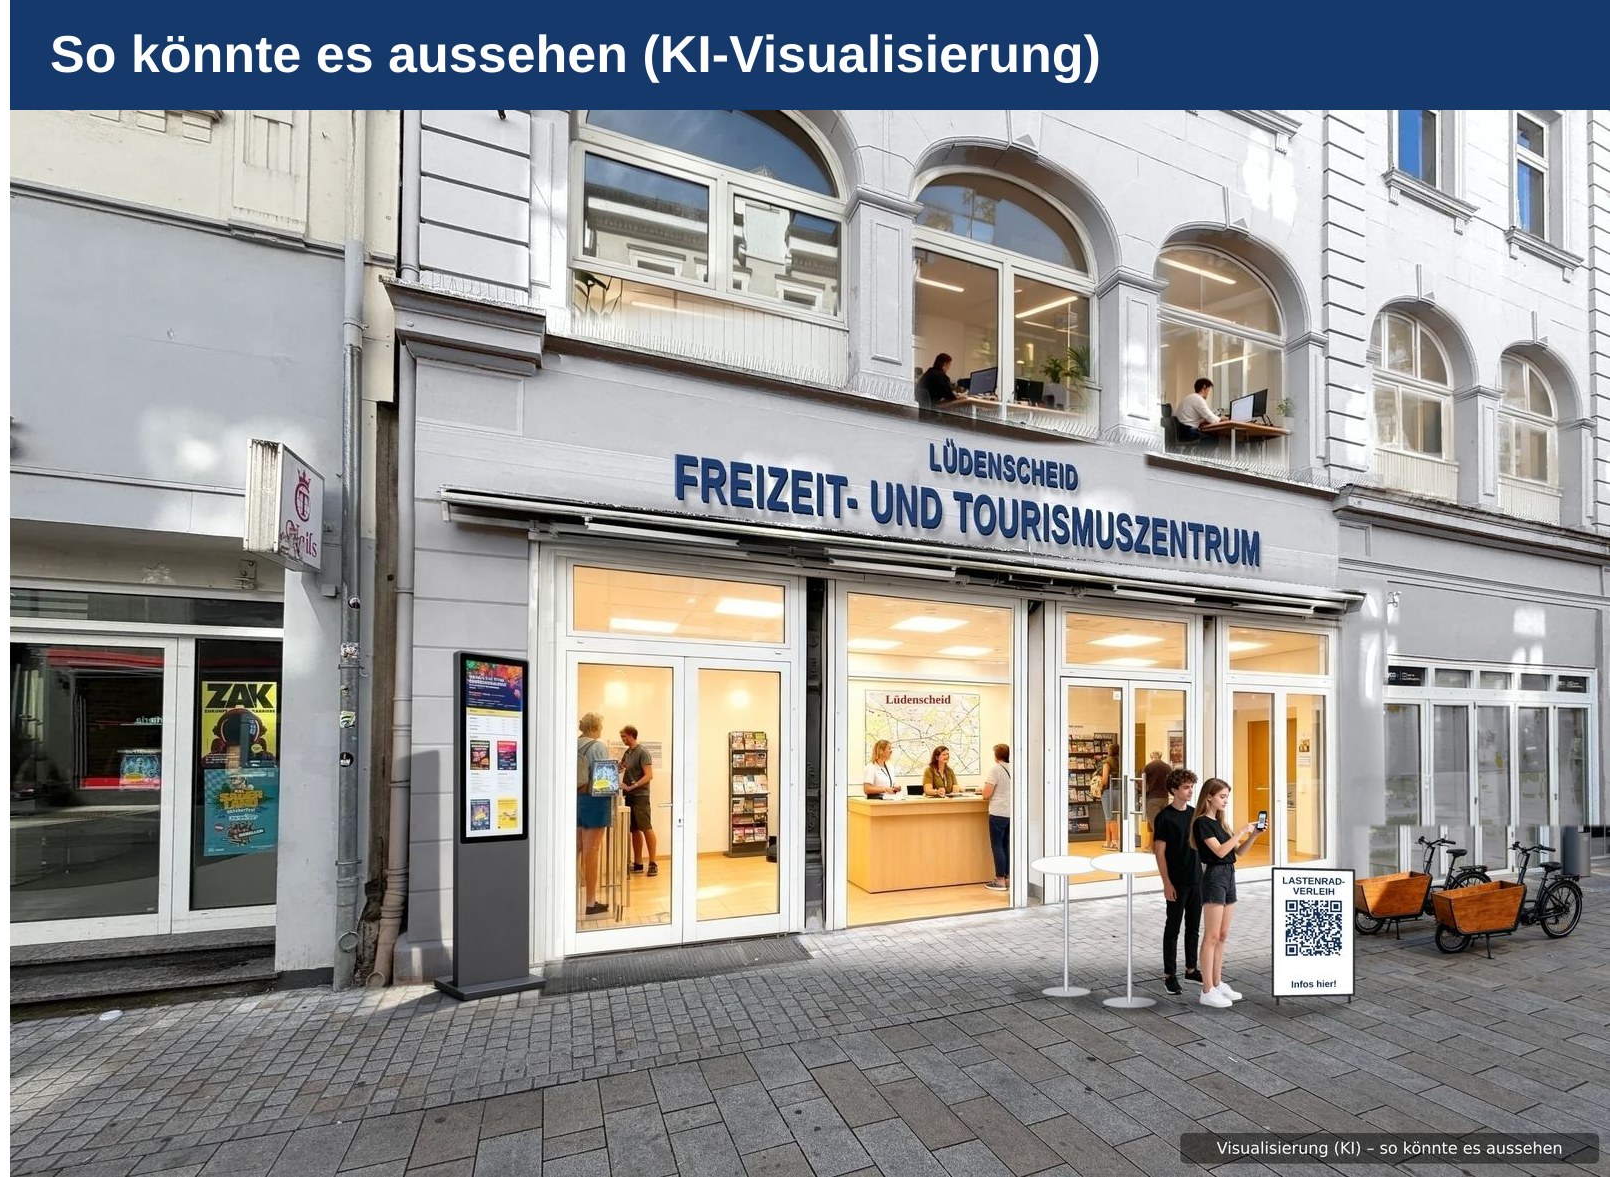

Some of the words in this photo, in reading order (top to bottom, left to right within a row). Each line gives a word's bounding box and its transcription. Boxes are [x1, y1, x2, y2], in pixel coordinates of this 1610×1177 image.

[929, 438, 1079, 491] LÜDENSCHEID
[675, 453, 858, 519] FREIZEIT-
[870, 480, 943, 530] UND
[953, 492, 1261, 567] TOURISMUSZENTRUM
[205, 683, 275, 709] ZAK
[885, 694, 952, 705] Lüdenscheid
[1282, 876, 1346, 886] LASTENRAD-
[1292, 887, 1335, 896] VERLEIH
[1291, 980, 1314, 989] Infos
[1316, 980, 1337, 988] hier!
